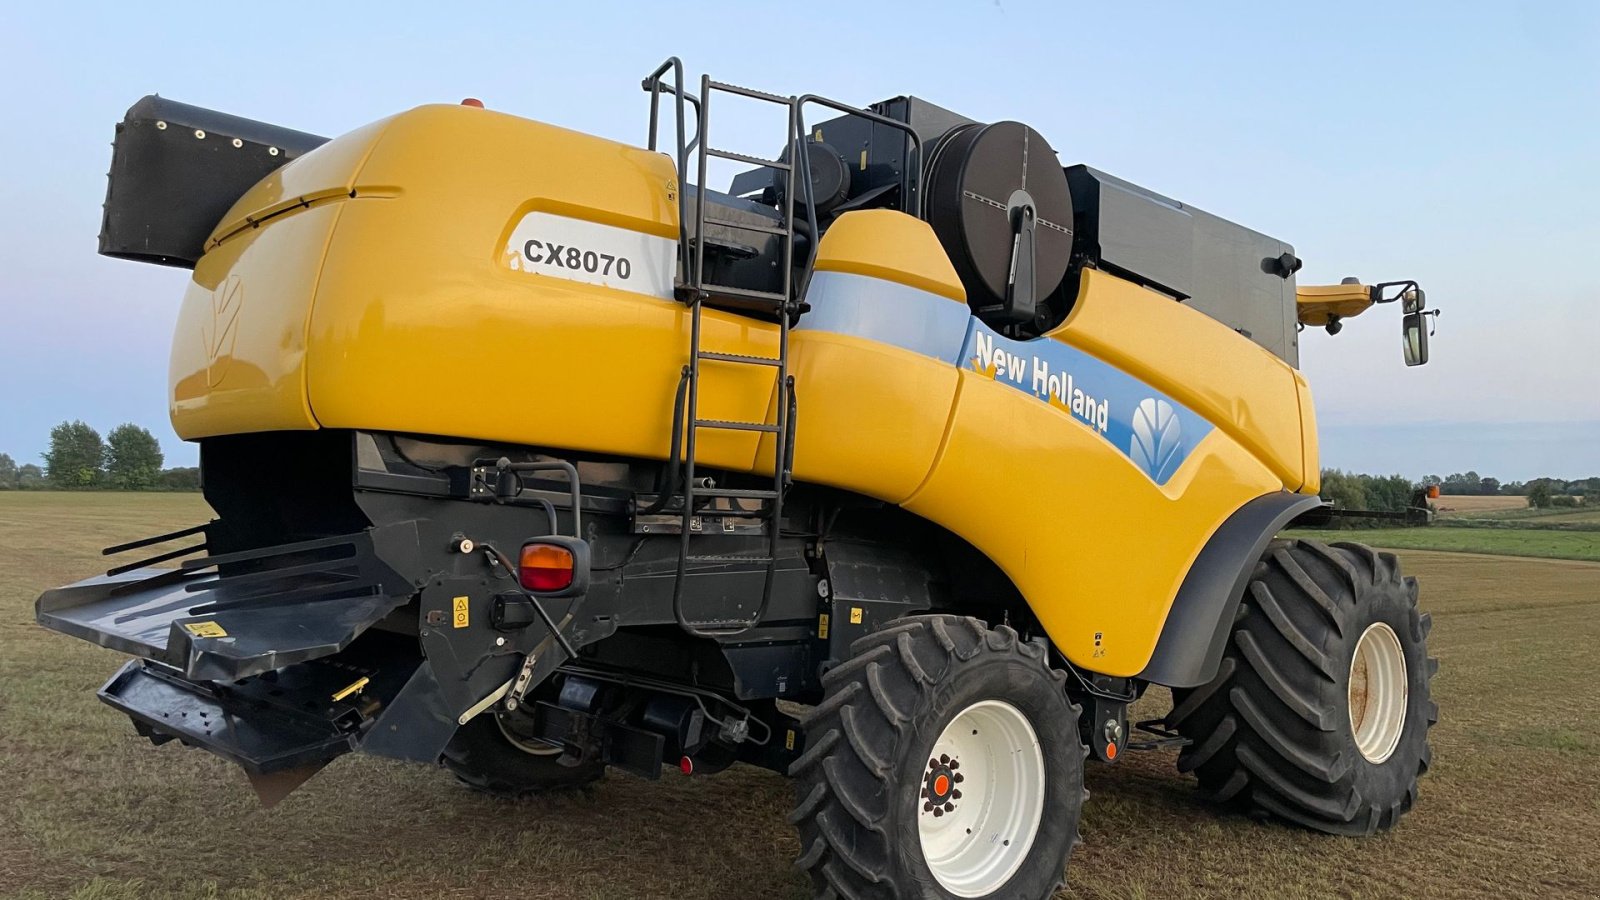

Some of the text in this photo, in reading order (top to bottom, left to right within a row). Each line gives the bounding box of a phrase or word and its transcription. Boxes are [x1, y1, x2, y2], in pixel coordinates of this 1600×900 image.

[524, 239, 631, 279] CX8070
[976, 331, 1108, 432] New Holland
